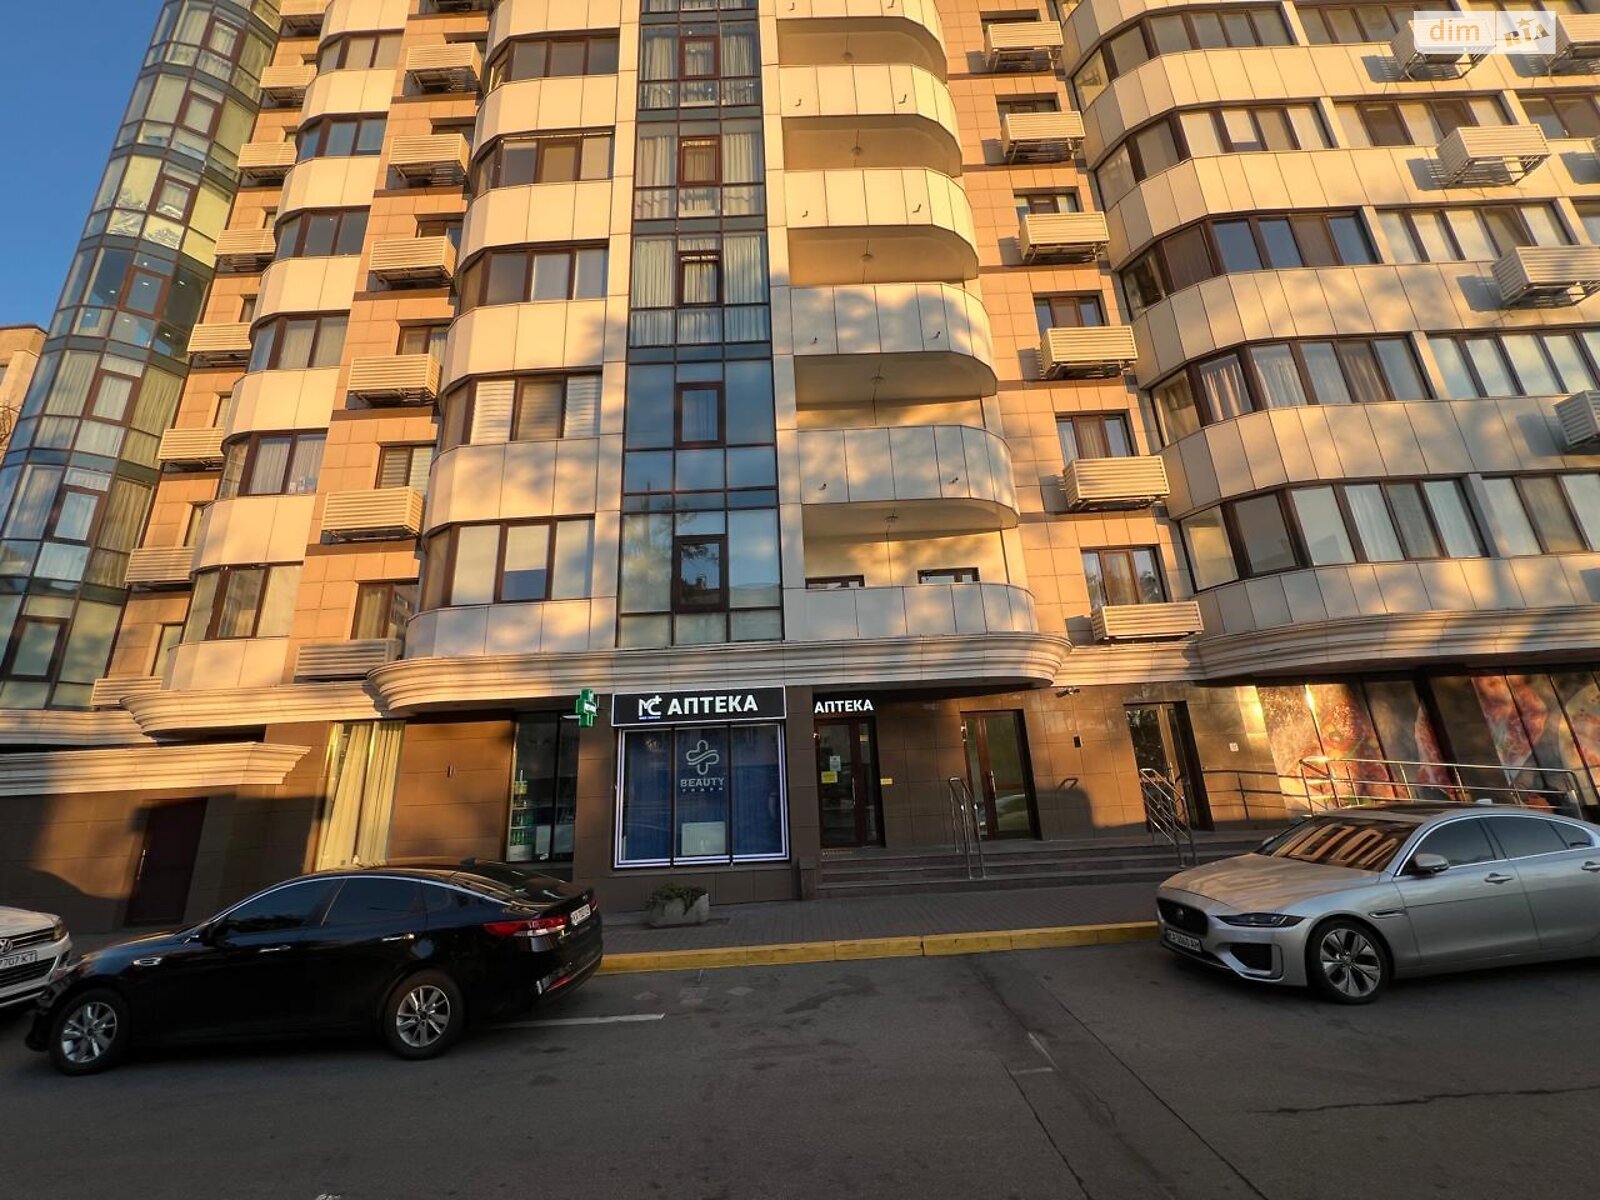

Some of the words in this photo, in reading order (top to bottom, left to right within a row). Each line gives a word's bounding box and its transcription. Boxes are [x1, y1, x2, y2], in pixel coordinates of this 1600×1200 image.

[667, 694, 758, 715] АПТЕКА
[814, 699, 874, 714] АПТЕКА
[680, 777, 725, 787] BEAUTY
